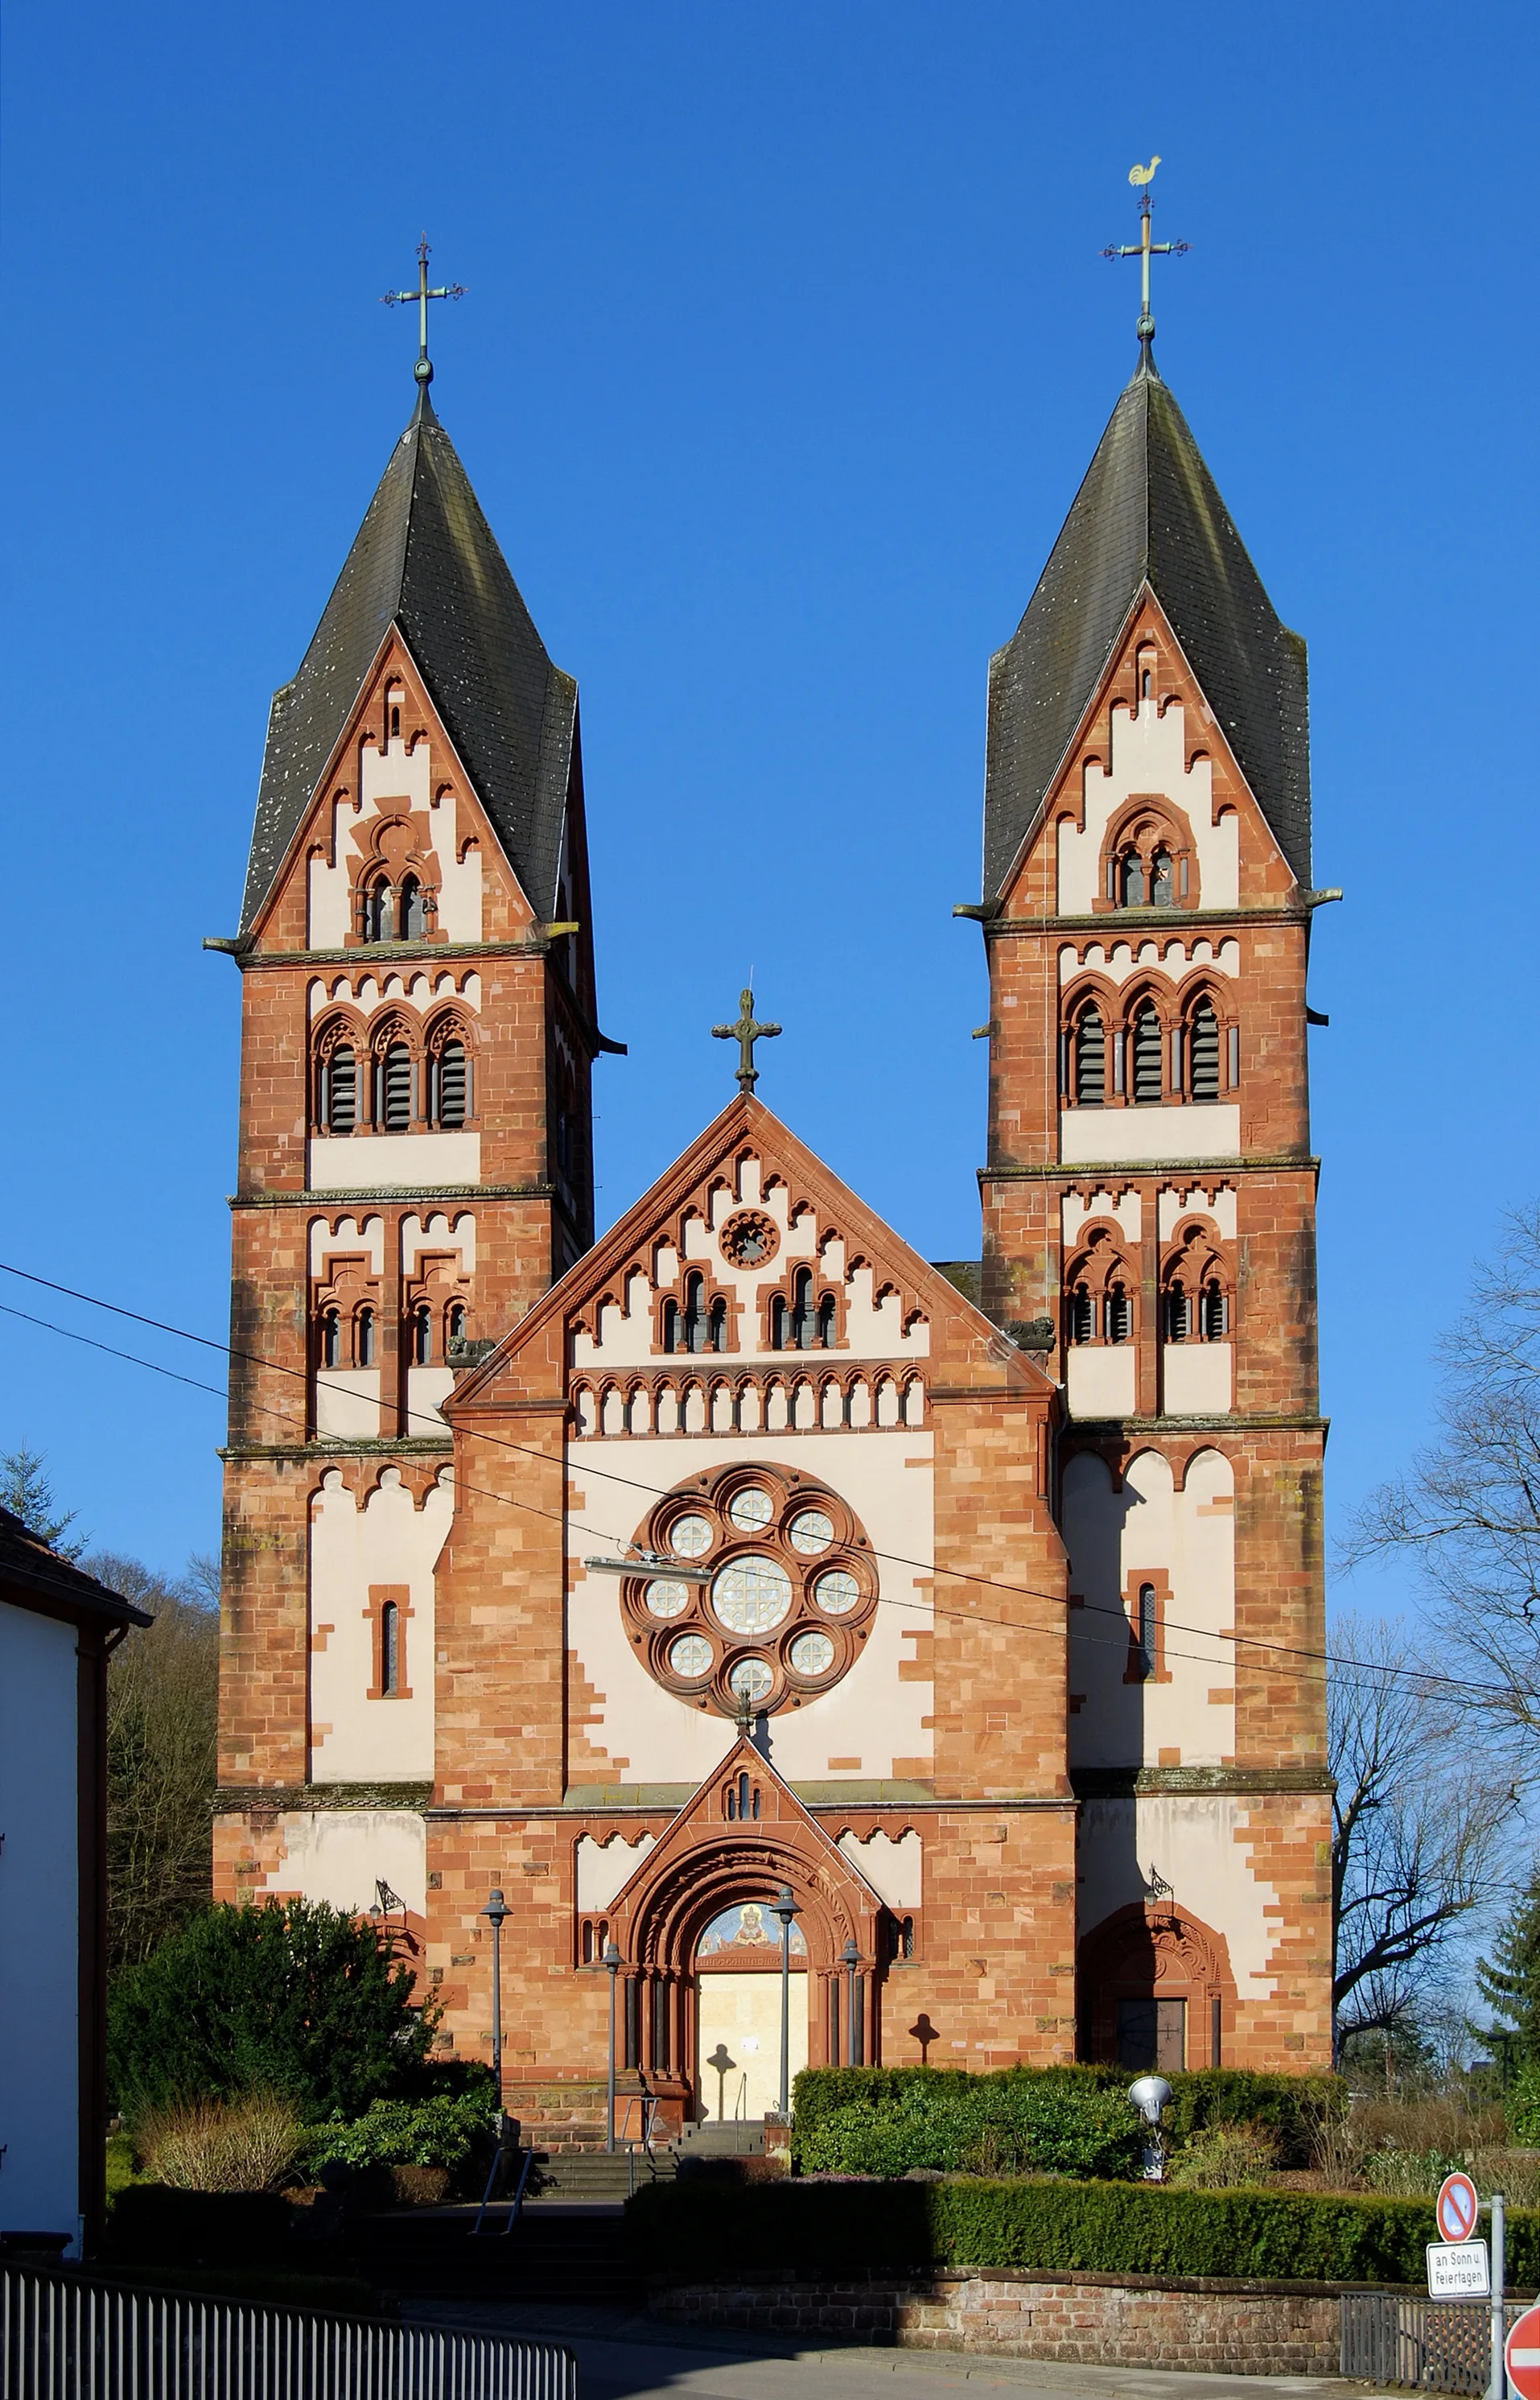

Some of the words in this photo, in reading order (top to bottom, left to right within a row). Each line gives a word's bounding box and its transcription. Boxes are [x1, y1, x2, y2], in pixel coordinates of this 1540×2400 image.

[1435, 2256, 1447, 2266] an
[1451, 2252, 1472, 2266] Sonn
[1473, 2254, 1480, 2264] u.
[1435, 2270, 1482, 2287] Feiertagen
